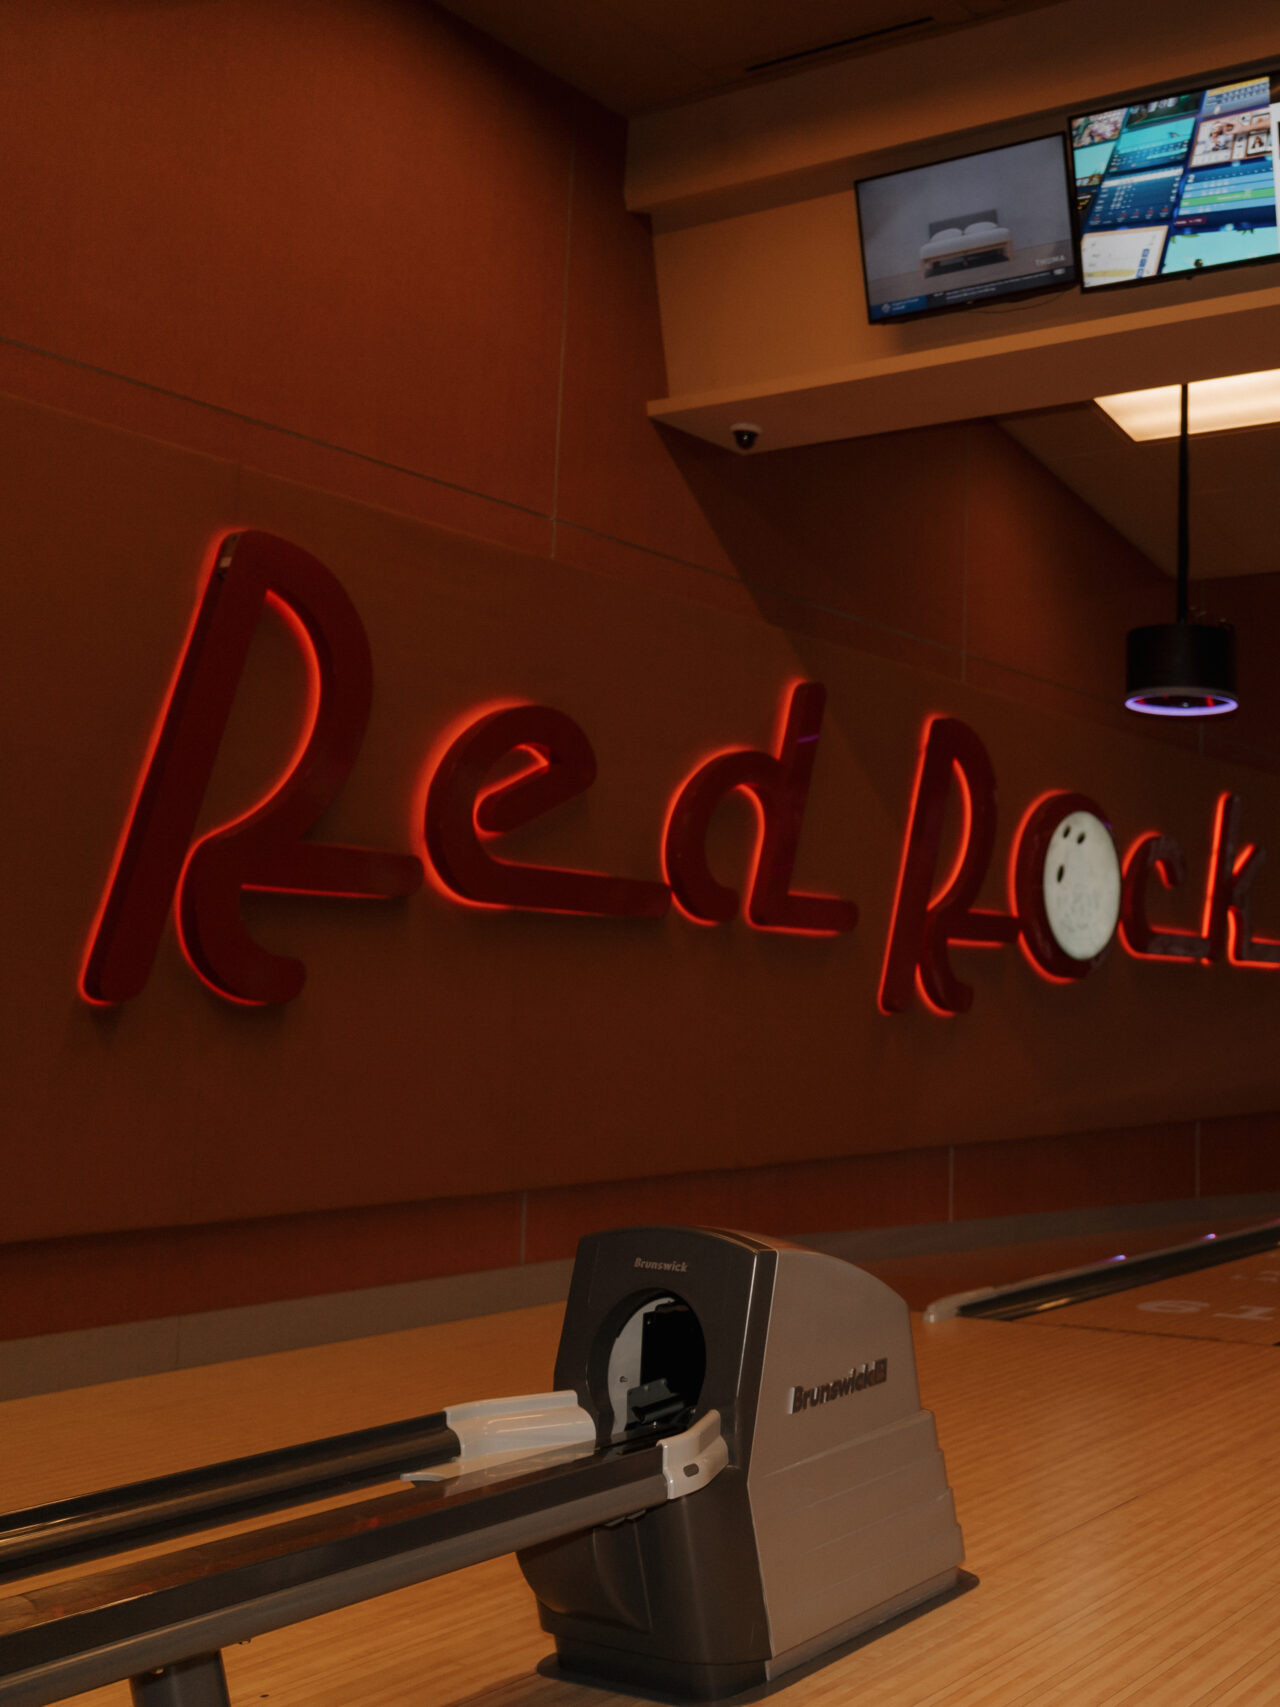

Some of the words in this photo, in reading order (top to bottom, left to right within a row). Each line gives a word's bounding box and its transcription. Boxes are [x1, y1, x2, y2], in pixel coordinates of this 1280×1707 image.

[77, 527, 858, 1008] Red
[633, 1257, 688, 1273] Brunswick
[786, 1361, 876, 1415] Brunswick
